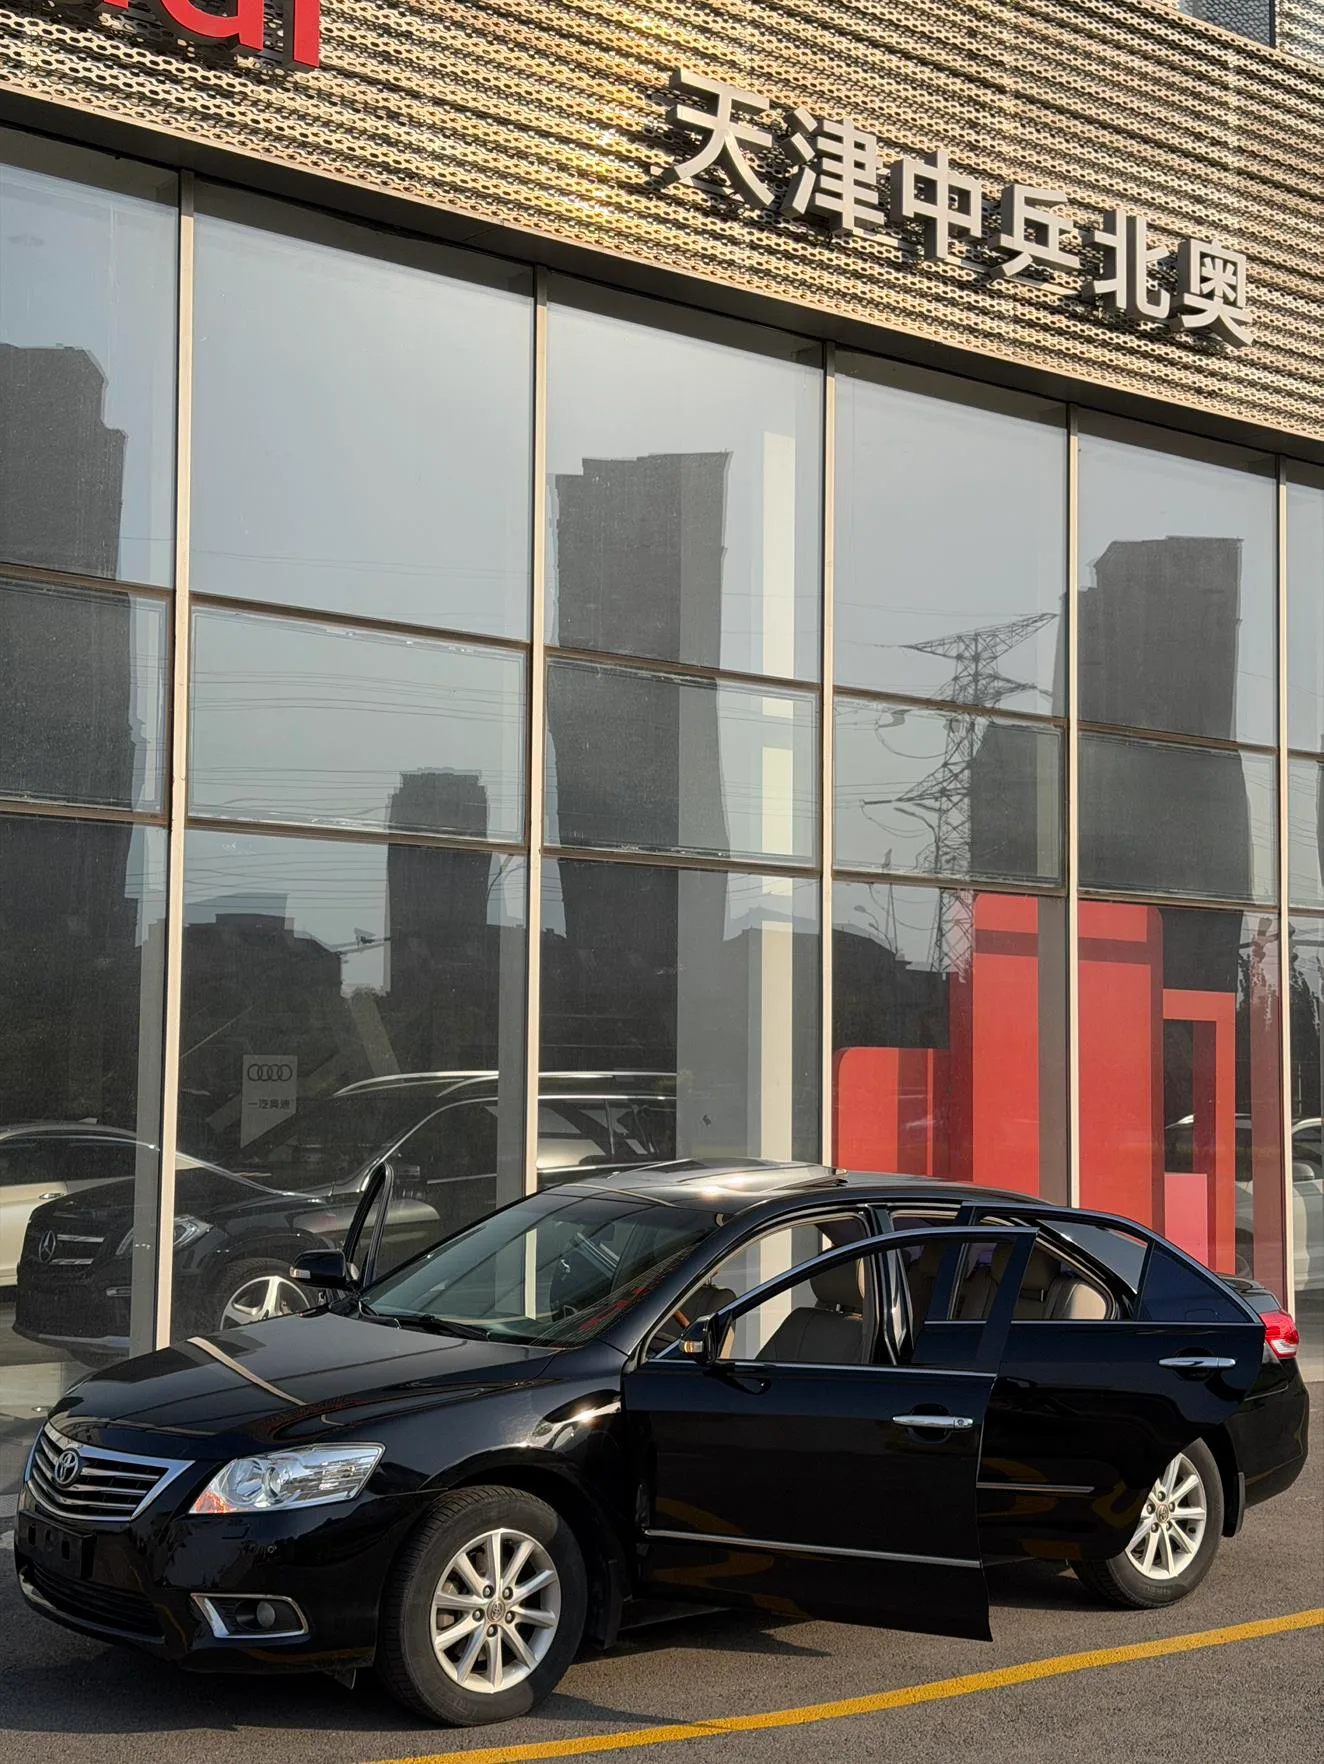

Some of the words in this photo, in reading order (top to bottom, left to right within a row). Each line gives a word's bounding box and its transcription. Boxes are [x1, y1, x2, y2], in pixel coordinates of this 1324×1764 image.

[666, 68, 1255, 347] 天津中乒北奥
